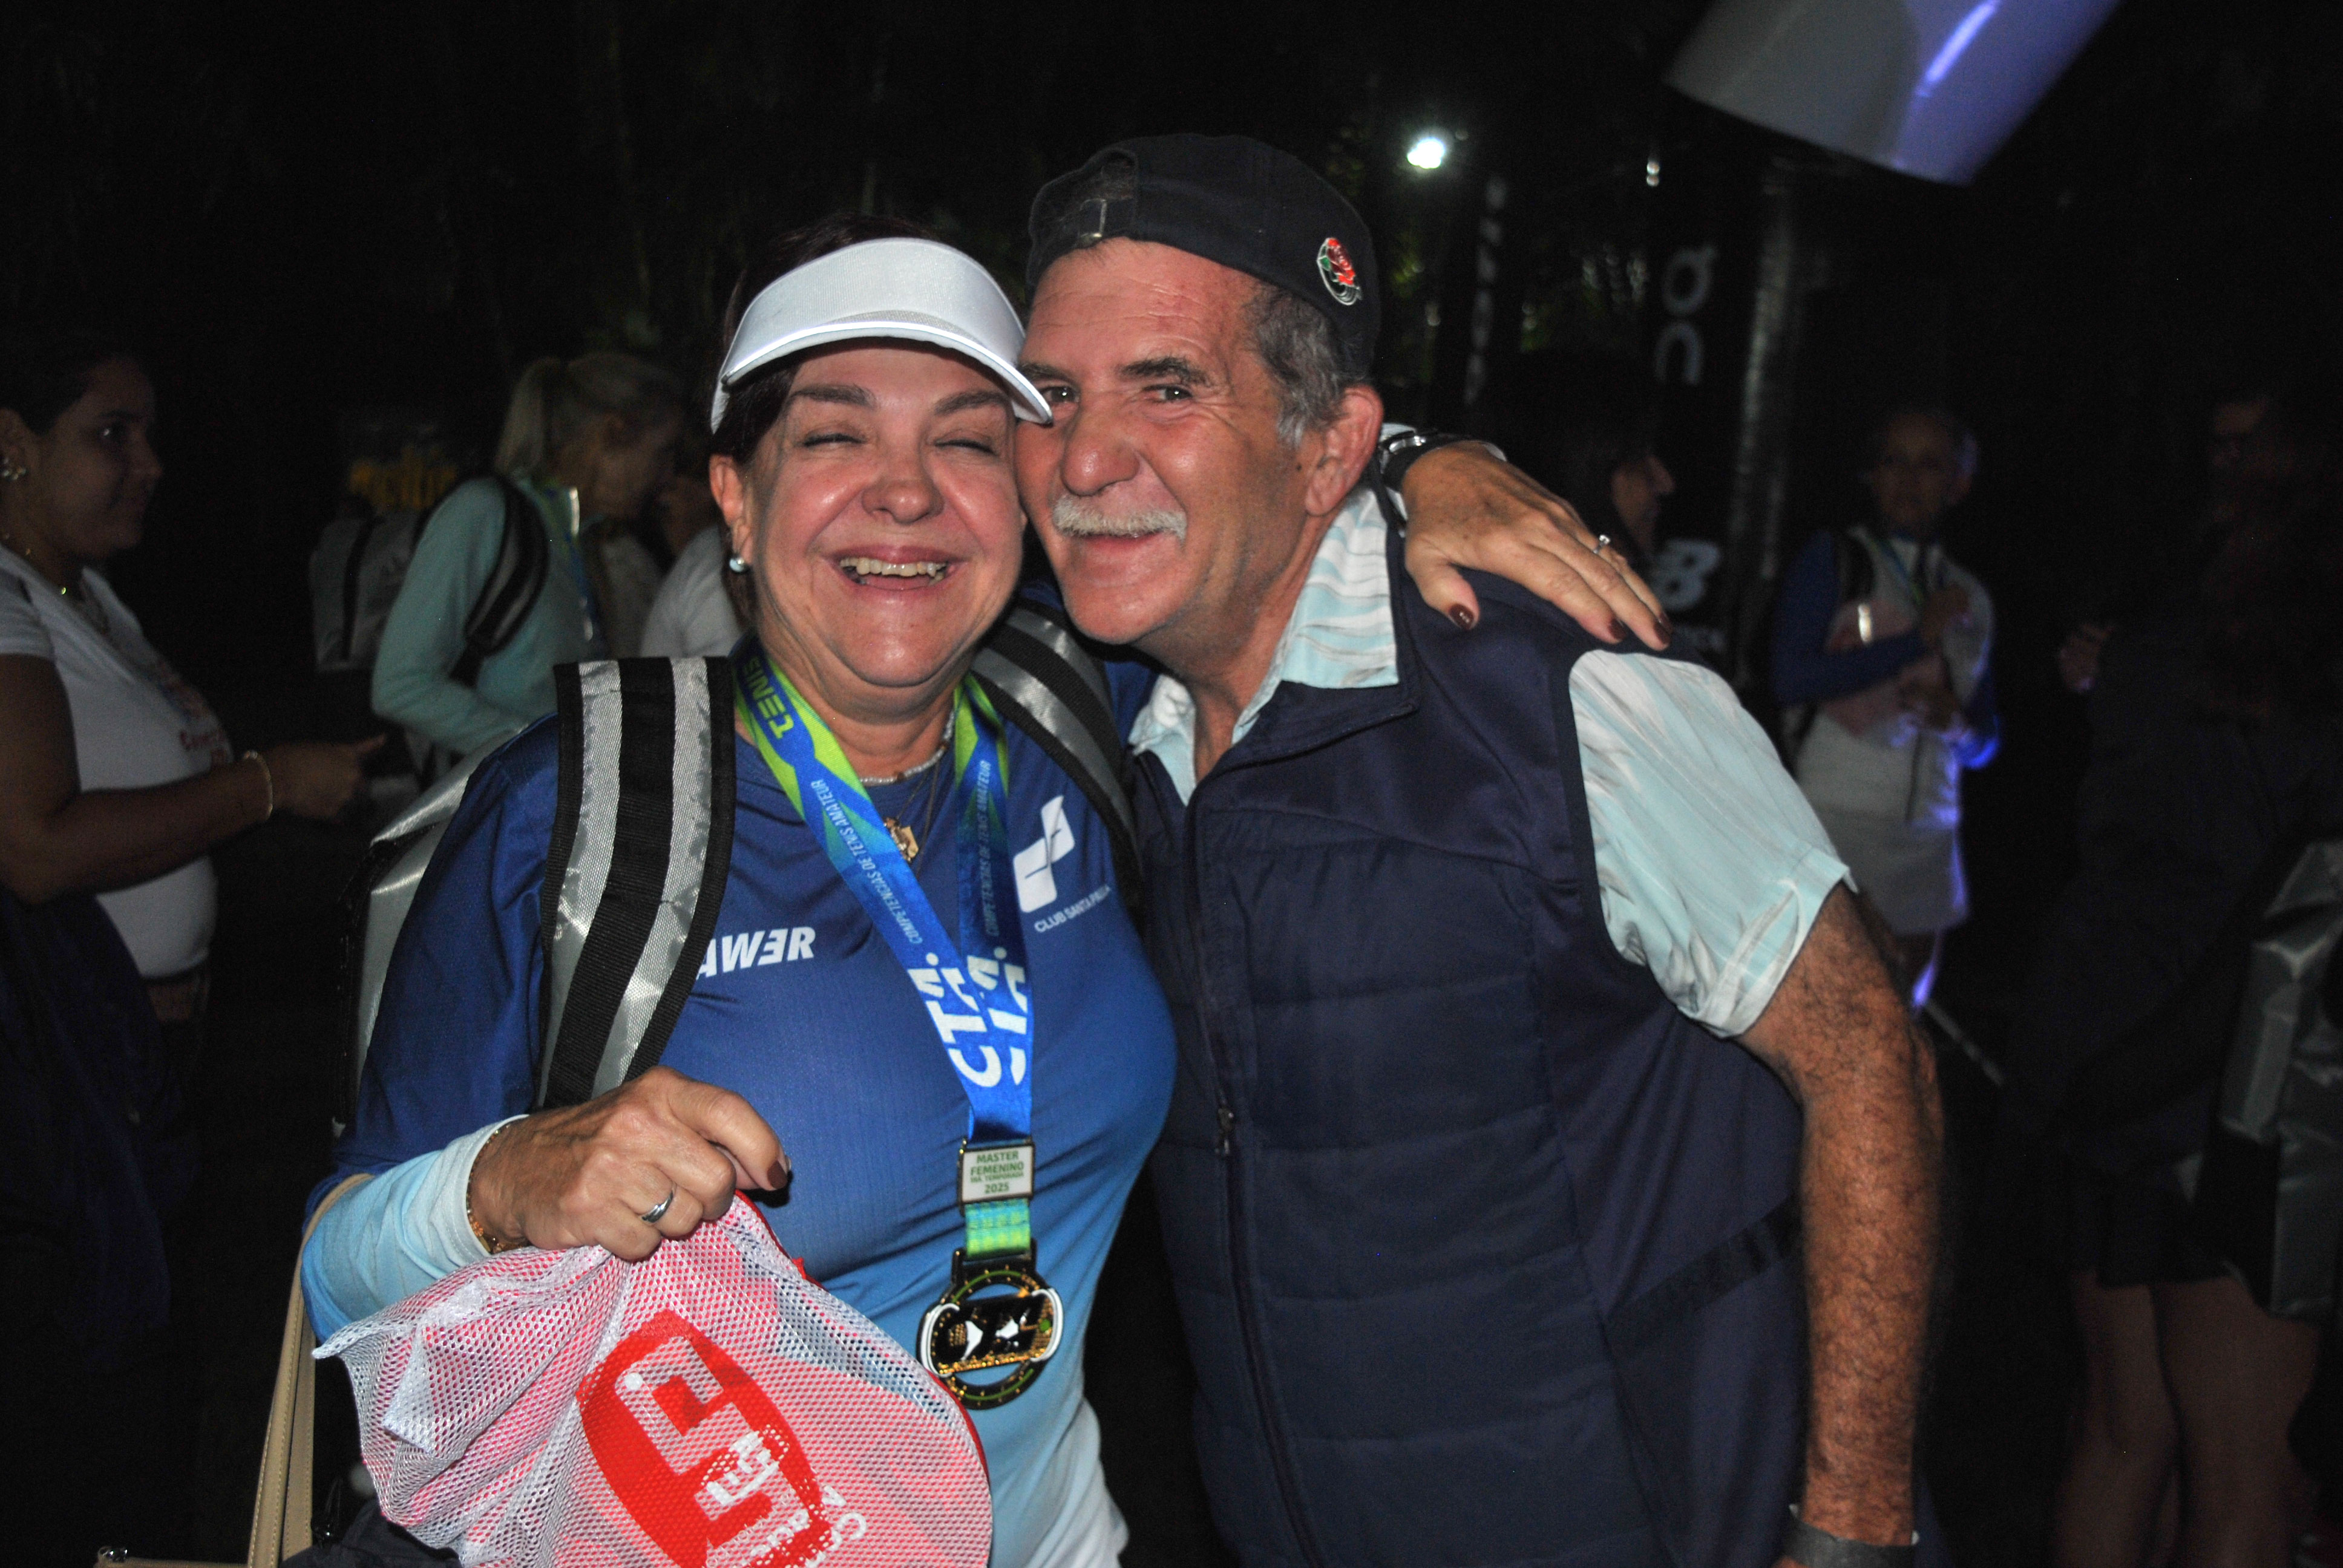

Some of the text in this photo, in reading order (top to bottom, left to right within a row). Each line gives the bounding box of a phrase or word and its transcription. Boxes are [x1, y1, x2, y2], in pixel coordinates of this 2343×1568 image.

[744, 658, 794, 739] TENIS
[810, 779, 923, 944] COMPETENCIAS DE TENIS AMATEUR
[1034, 911, 1067, 933] CLUB
[977, 1151, 1019, 1163] MASTER
[971, 1161, 1024, 1176] FEMENINO
[985, 1182, 1010, 1194] 2025
